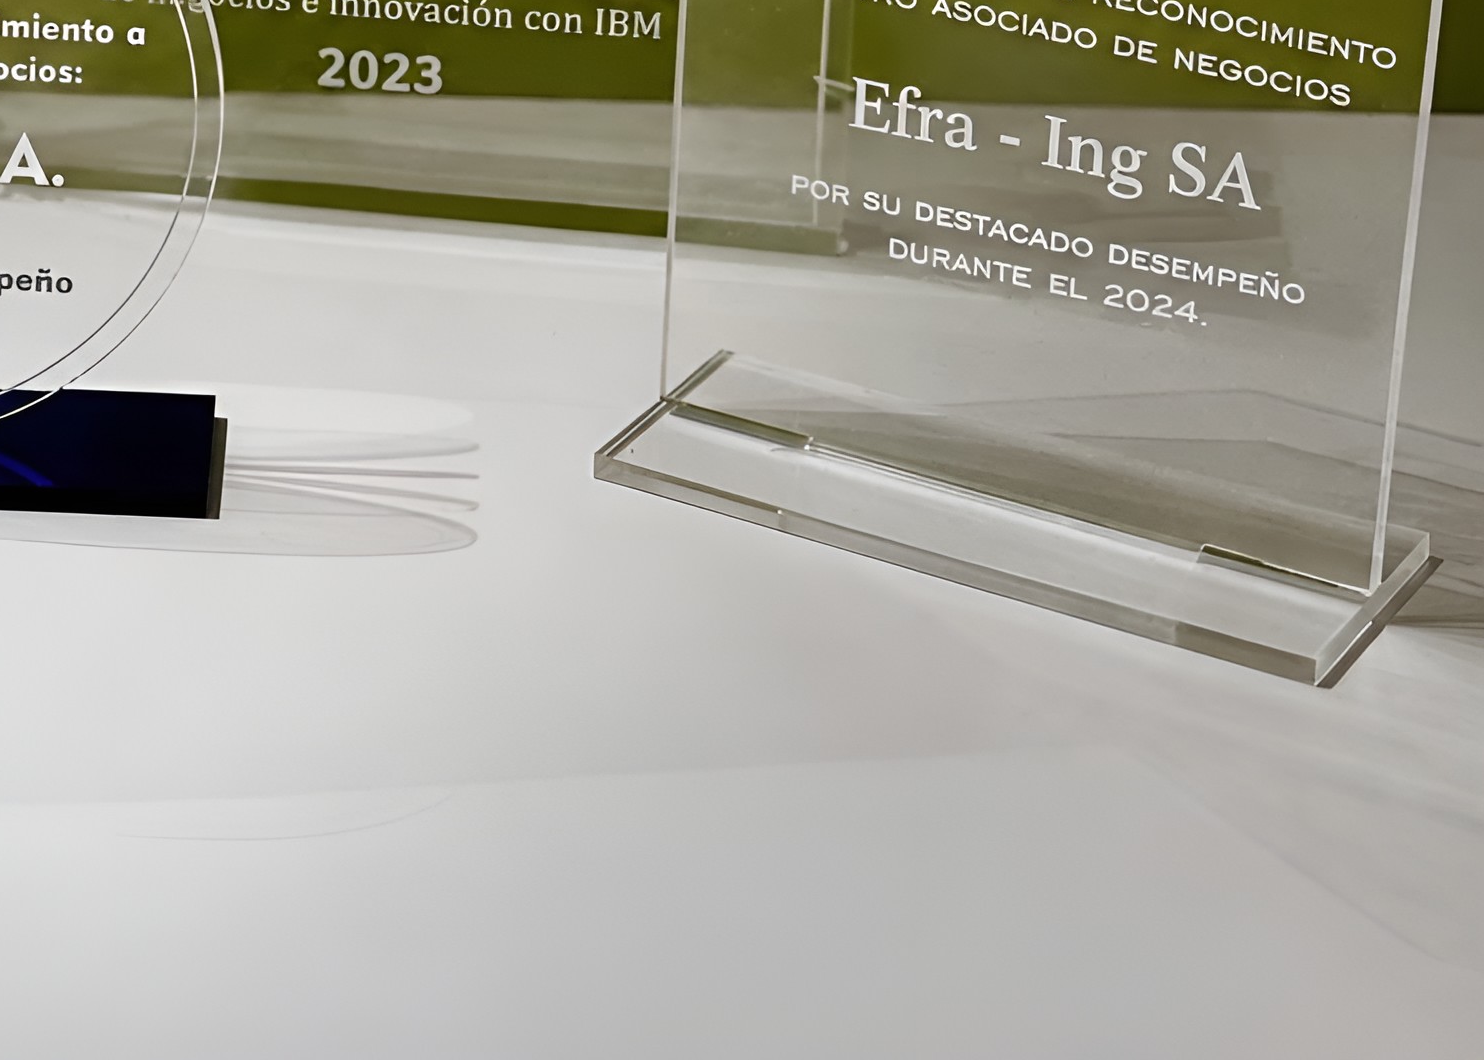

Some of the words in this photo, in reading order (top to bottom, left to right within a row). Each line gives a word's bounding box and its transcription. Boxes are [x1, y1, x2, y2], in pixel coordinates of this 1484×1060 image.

[126, 26, 147, 47] a
[524, 9, 583, 35] con
[594, 7, 662, 40] IBM
[317, 46, 444, 95] 2023
[1113, 33, 1159, 66] DE
[1173, 47, 1352, 108] NEGOCIOS
[848, 75, 978, 153] Efra
[1040, 114, 1148, 201] Ing
[1168, 140, 1263, 212] SA
[790, 174, 851, 207] POR
[862, 190, 902, 217] SU
[915, 200, 1094, 259] DESTACADO
[1107, 242, 1306, 306] DESEMPEÑO
[888, 236, 1033, 290] DURANTE
[1049, 274, 1088, 301] EL
[1102, 284, 1208, 328] 2024.
